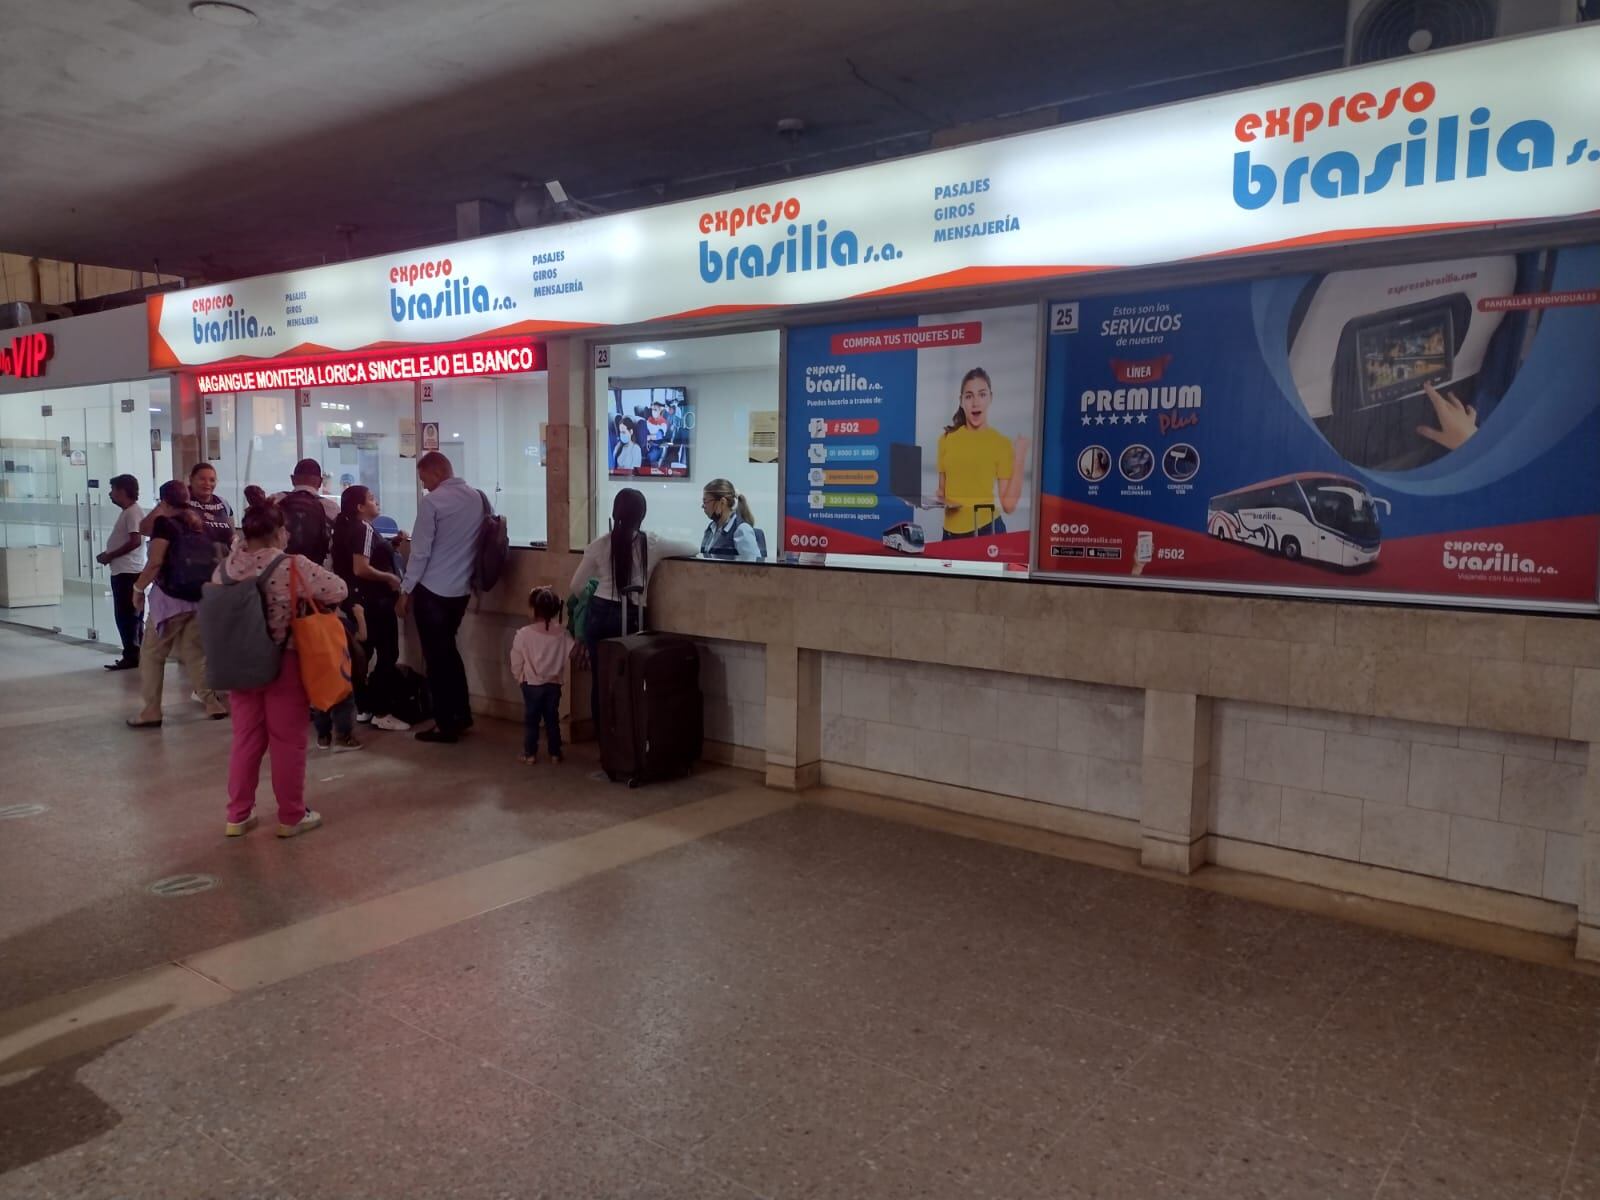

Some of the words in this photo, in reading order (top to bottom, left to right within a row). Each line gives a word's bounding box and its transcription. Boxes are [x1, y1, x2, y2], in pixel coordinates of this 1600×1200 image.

[1235, 81, 1436, 143] expreso
[1233, 107, 1555, 210] brasilia
[934, 178, 990, 200] PASAJES
[699, 197, 801, 236] expreso
[934, 203, 975, 221] GIROS
[933, 215, 1020, 243] MENSAJERÍA
[532, 251, 565, 265] PASAJES
[700, 219, 858, 283] brasilia
[864, 243, 903, 263] s.a.
[390, 258, 453, 286] expreso
[533, 269, 557, 281] GIROS
[533, 279, 583, 297] MENSAJERÍA
[1387, 271, 1477, 295] expresobrasilia.com
[192, 294, 233, 314] expreso
[285, 291, 307, 301] PASAJES
[391, 276, 489, 322] brasilia
[493, 296, 517, 311] s.a.
[1485, 298, 1532, 308] PANTALLAS
[1534, 293, 1597, 305] INDIVIDUALES
[286, 305, 302, 314] GIROS
[1056, 309, 1073, 326] 25
[1113, 306, 1136, 316] Estos
[1138, 304, 1154, 313] son
[1156, 303, 1170, 312] los
[193, 309, 259, 344] brasilia
[1101, 314, 1182, 336] SERVICIOS
[843, 336, 881, 349] COMPRA
[883, 334, 900, 345] TUS
[903, 331, 949, 344] TIQUETES
[951, 329, 965, 340] DE
[1116, 337, 1127, 346] de
[1129, 335, 1164, 345] nuestra
[12, 332, 47, 378] VIP
[598, 350, 608, 363] 23
[256, 367, 316, 389] MONTERIA
[318, 363, 366, 384] LORICA
[368, 355, 449, 381] SINCELEJO
[806, 364, 846, 376] expreso
[1126, 365, 1151, 378] LÍNEA
[424, 386, 431, 398] 22
[806, 374, 868, 393] brasilia
[807, 399, 826, 407] Puedes
[828, 398, 848, 406] hacerlo
[1081, 385, 1202, 412] PREMIUM
[834, 423, 859, 433] #502
[857, 513, 880, 521] agencias
[1158, 548, 1185, 560] #502
[1443, 541, 1504, 553] expreso
[1443, 552, 1535, 573] brasilia
[1537, 566, 1559, 575] s.a.
